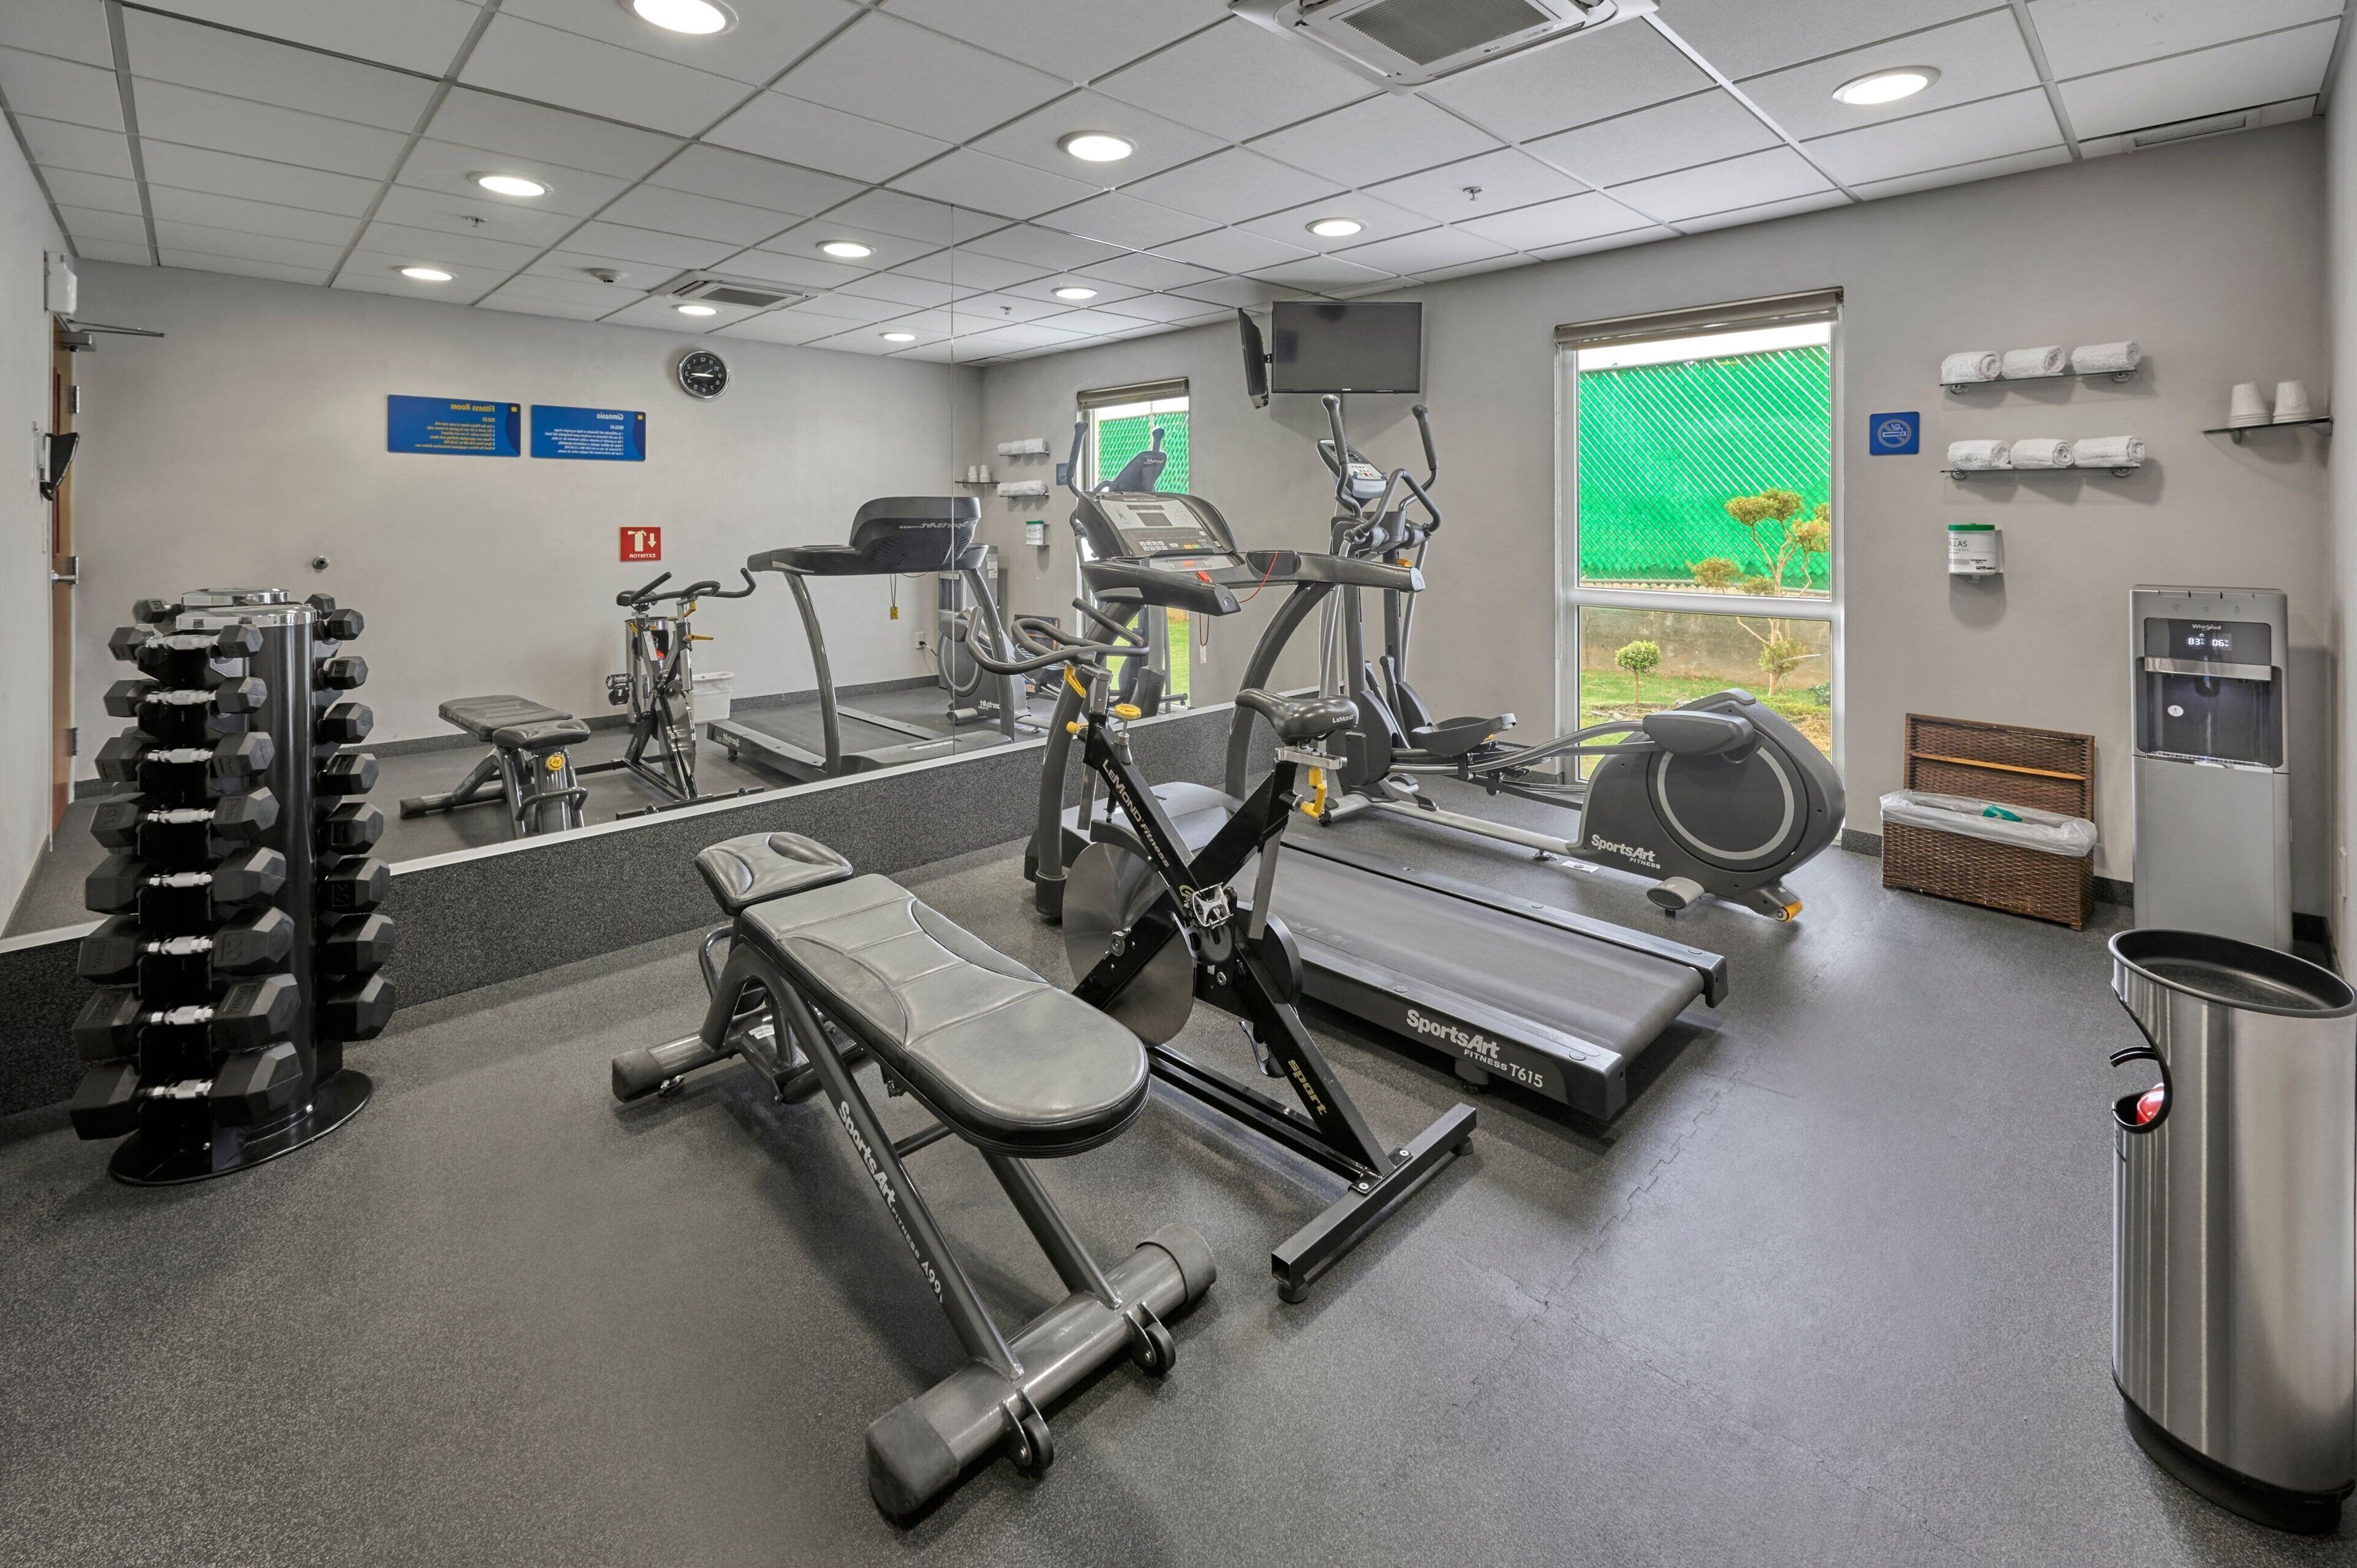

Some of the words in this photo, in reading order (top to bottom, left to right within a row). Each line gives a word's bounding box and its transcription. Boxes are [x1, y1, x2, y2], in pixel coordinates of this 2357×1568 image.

[1140, 823, 1169, 868] Fitness
[1591, 835, 1655, 862] SportsArt
[1630, 857, 1661, 869] FITNESS
[1406, 1009, 1500, 1059] SportsArt
[1288, 1059, 1327, 1116] sport
[1464, 1049, 1507, 1072] FITNESS
[1509, 1063, 1544, 1088] T615
[838, 1100, 896, 1208] SportsArt
[891, 1208, 921, 1260] FITNESS
